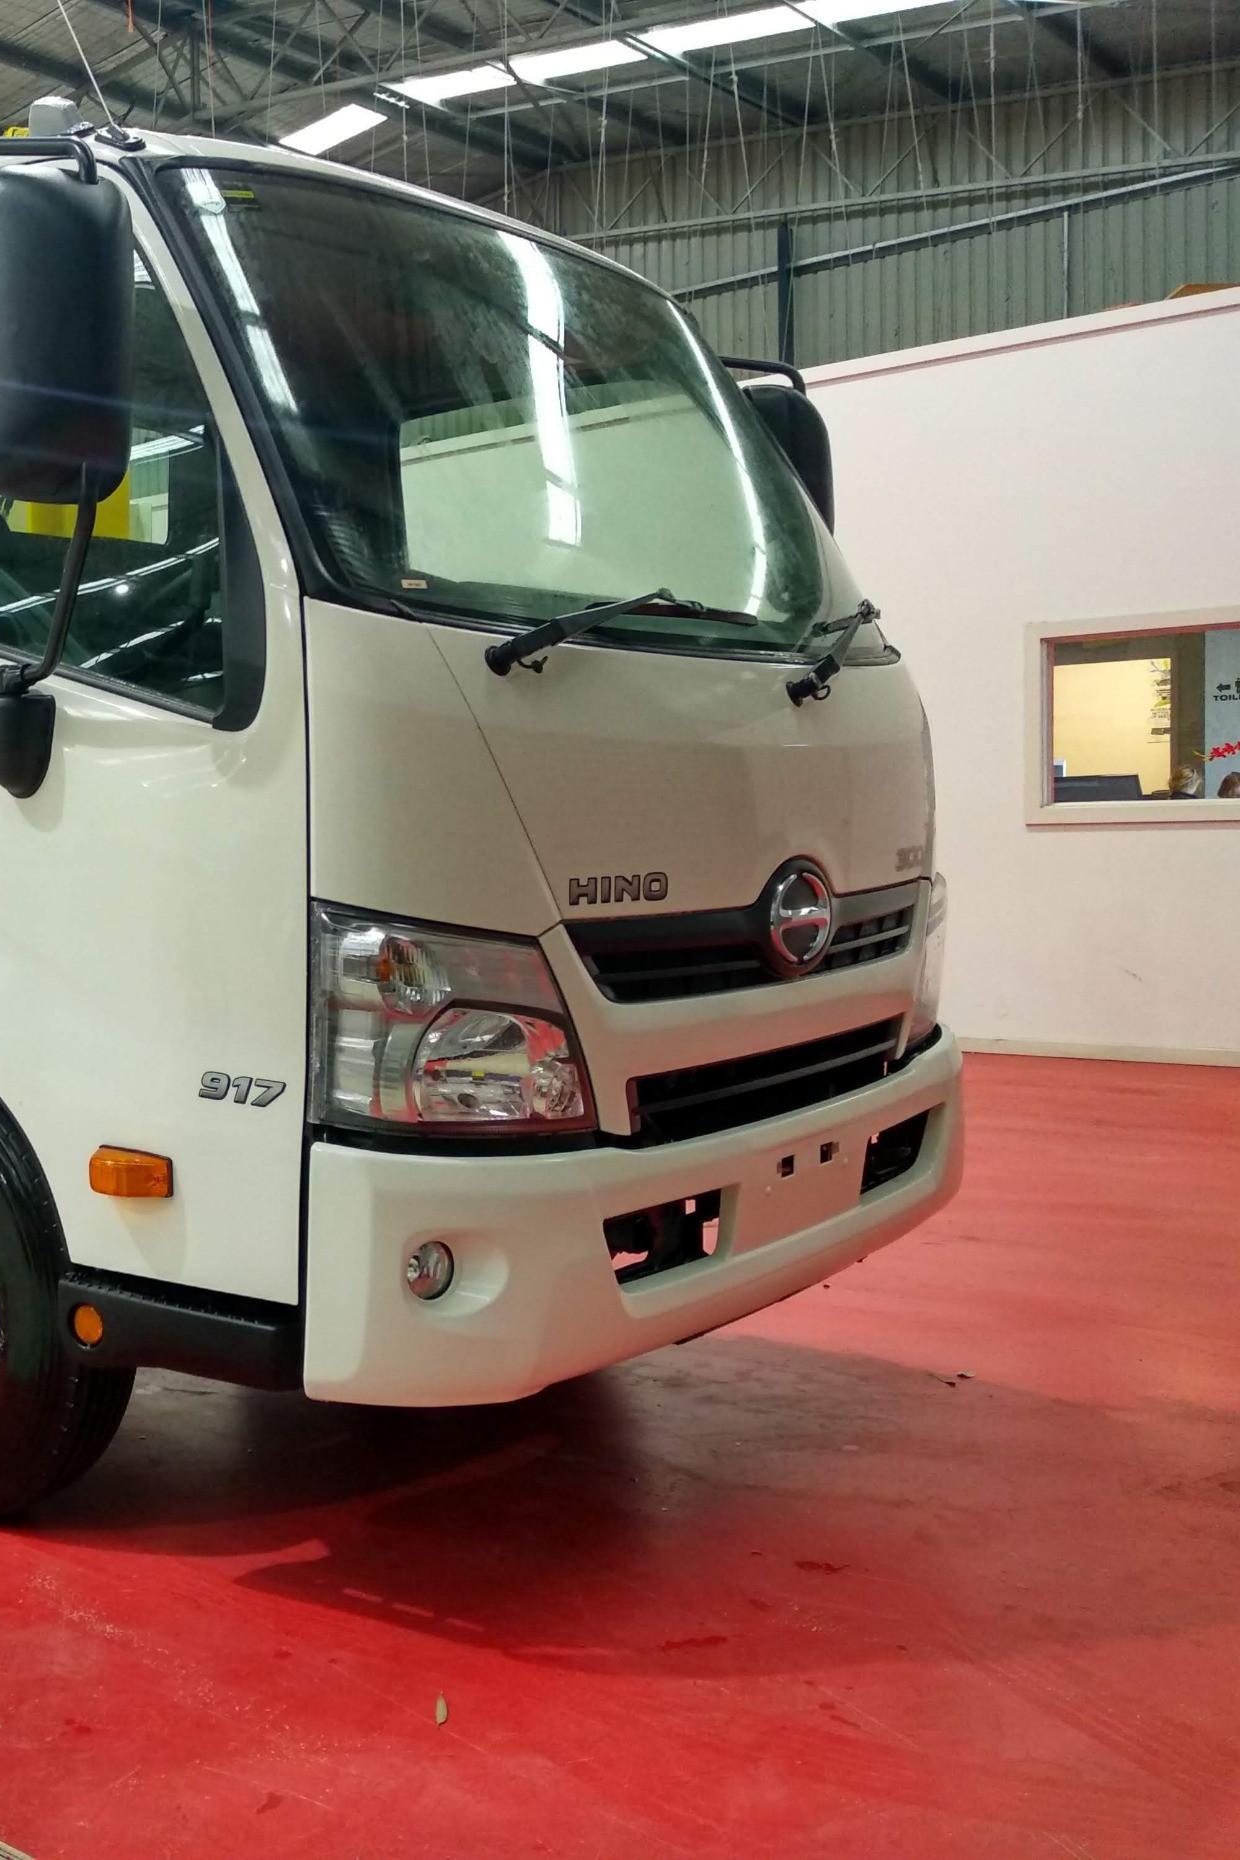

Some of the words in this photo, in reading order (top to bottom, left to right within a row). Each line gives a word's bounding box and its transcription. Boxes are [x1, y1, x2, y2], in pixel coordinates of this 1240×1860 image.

[1213, 694, 1240, 702] TOIL
[569, 871, 669, 906] HINO
[198, 1071, 287, 1108] 917
